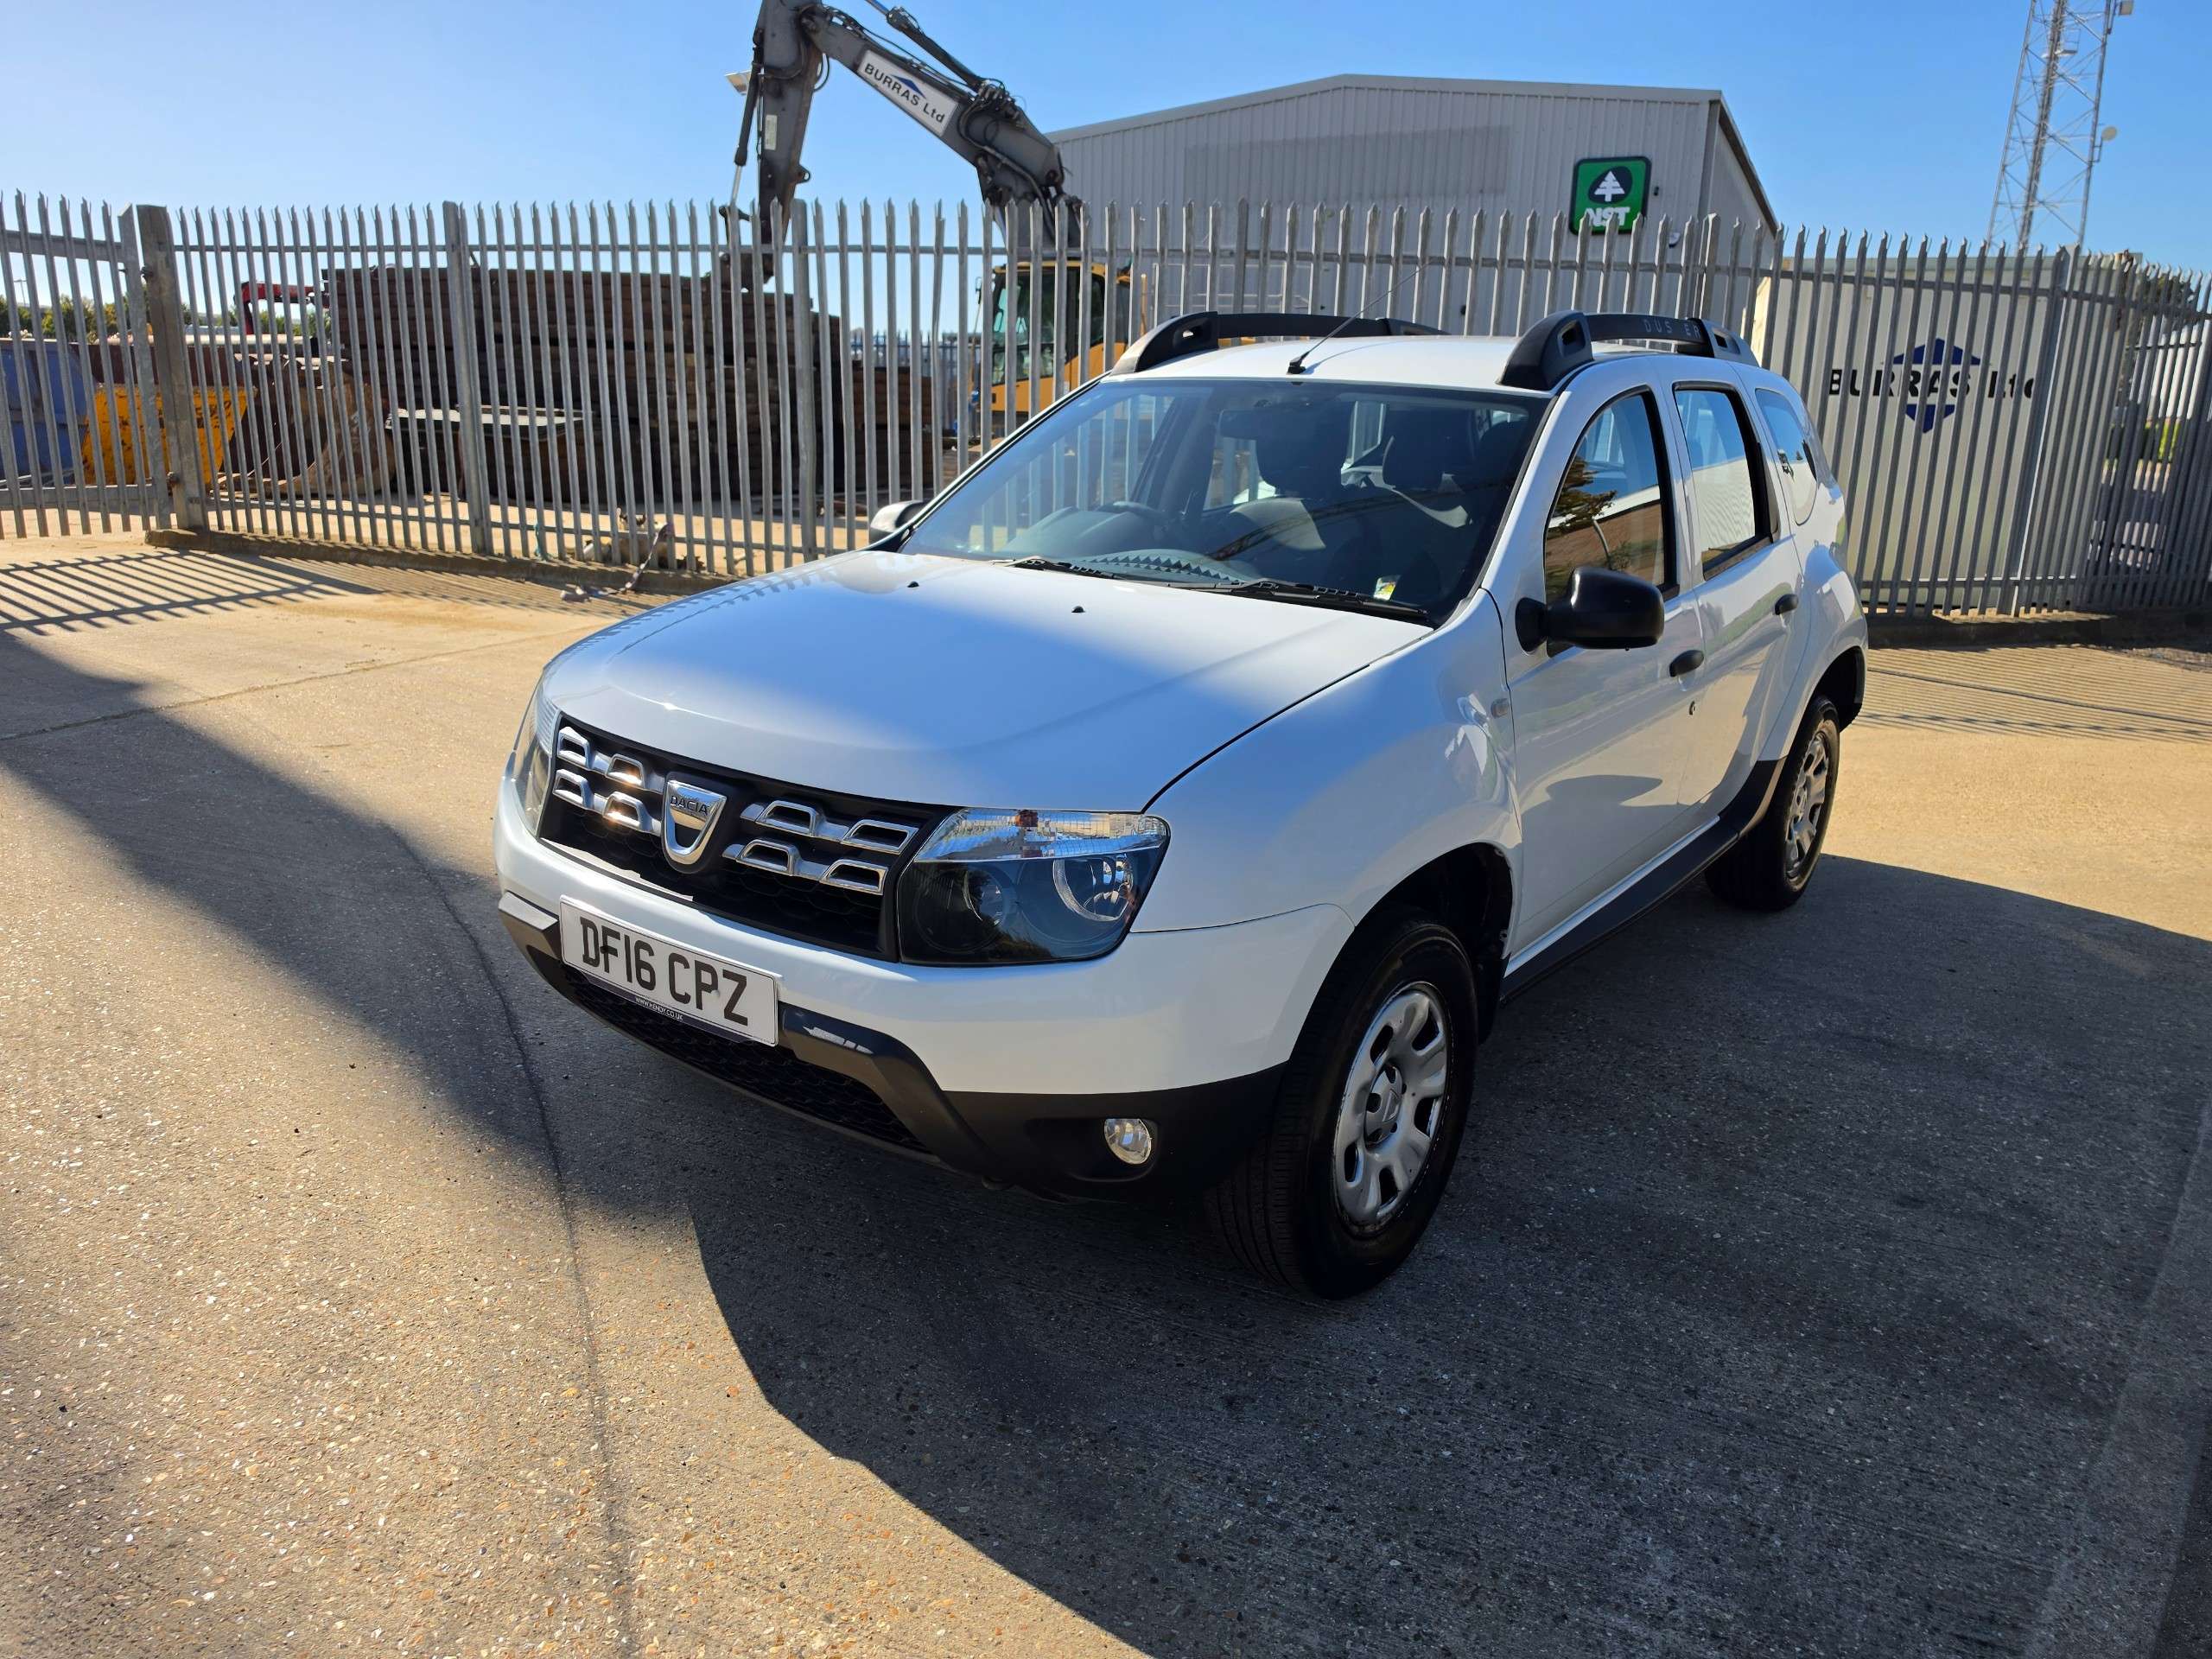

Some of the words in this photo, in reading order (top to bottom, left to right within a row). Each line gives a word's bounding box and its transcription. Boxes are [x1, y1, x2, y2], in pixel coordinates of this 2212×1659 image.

[865, 63, 919, 105] BURRAS
[923, 103, 945, 123] Ltd
[1643, 318, 1700, 339] DUSER
[671, 795, 708, 816] DACIA
[580, 916, 657, 992] DF16
[668, 952, 748, 1027] CPZ
